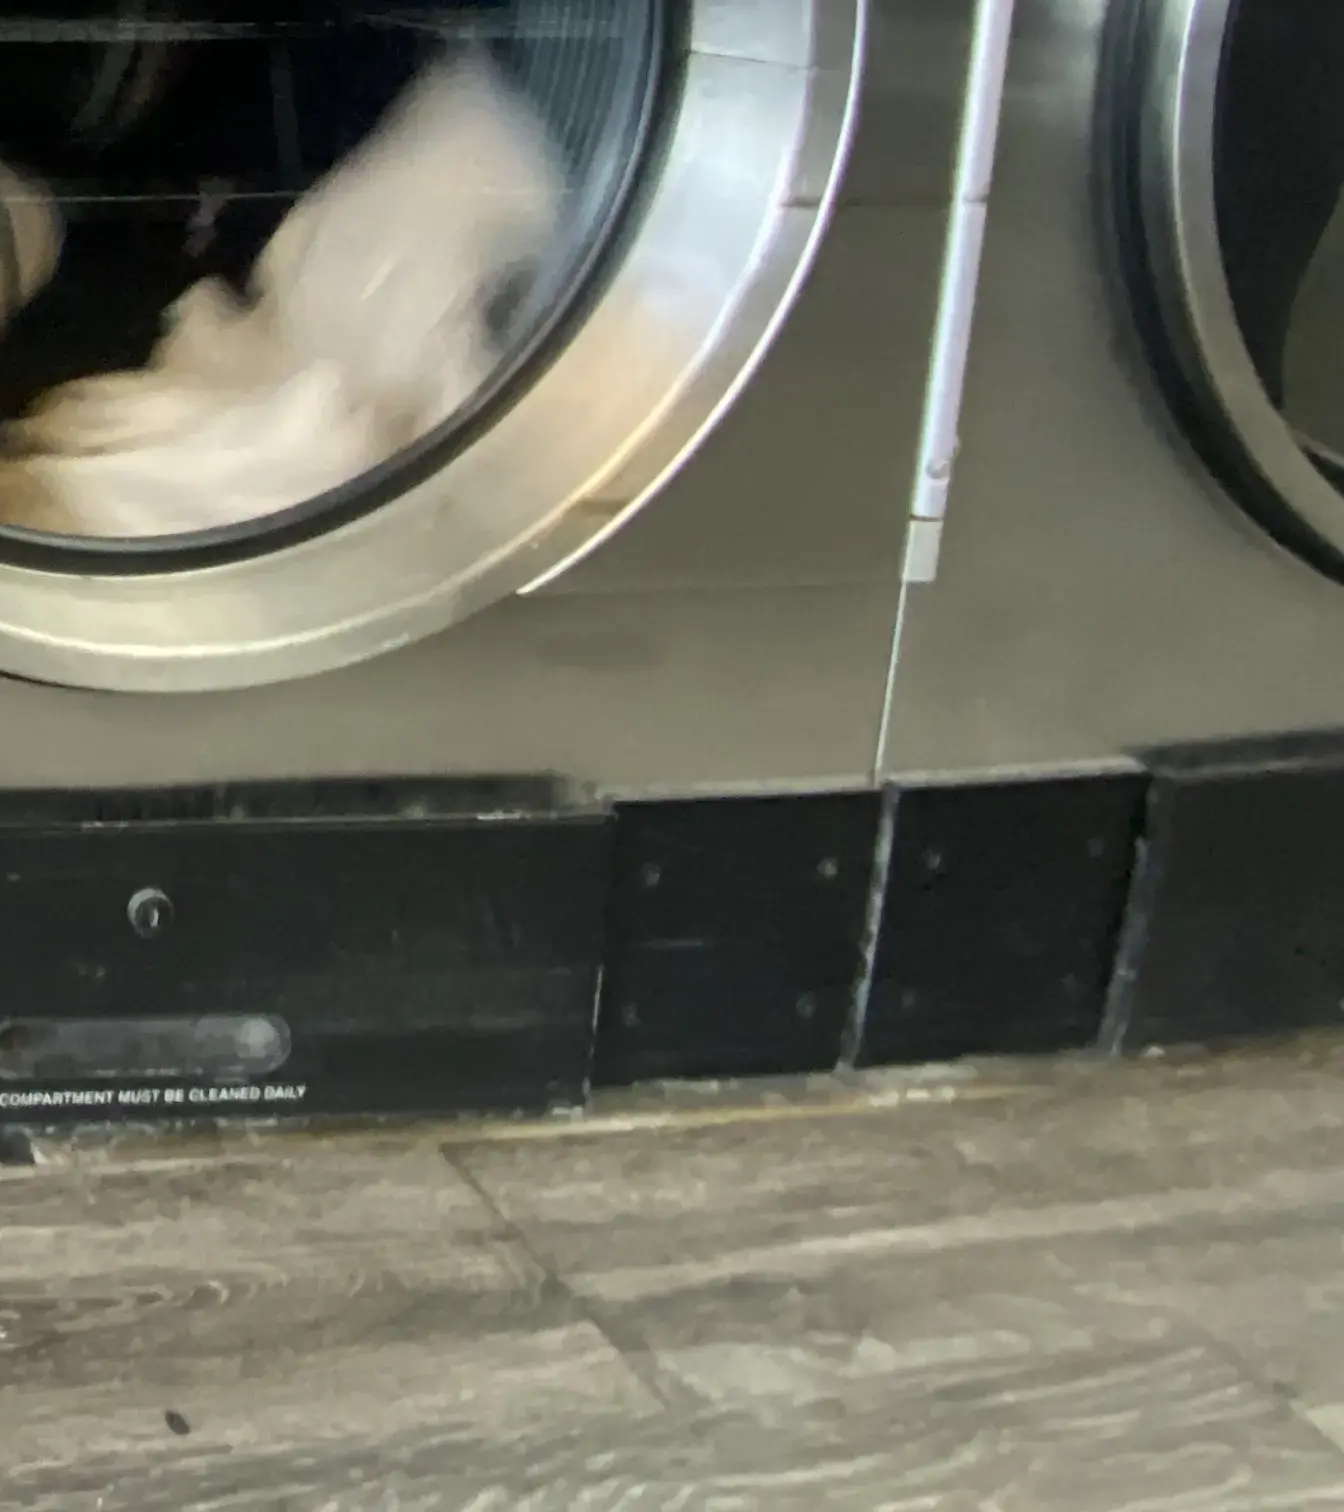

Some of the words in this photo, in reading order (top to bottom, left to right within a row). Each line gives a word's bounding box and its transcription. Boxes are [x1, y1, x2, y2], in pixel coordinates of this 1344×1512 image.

[118, 1088, 161, 1105] MUST
[164, 1087, 184, 1103] BE
[188, 1085, 262, 1102] CLEANED
[264, 1084, 307, 1101] DAILY
